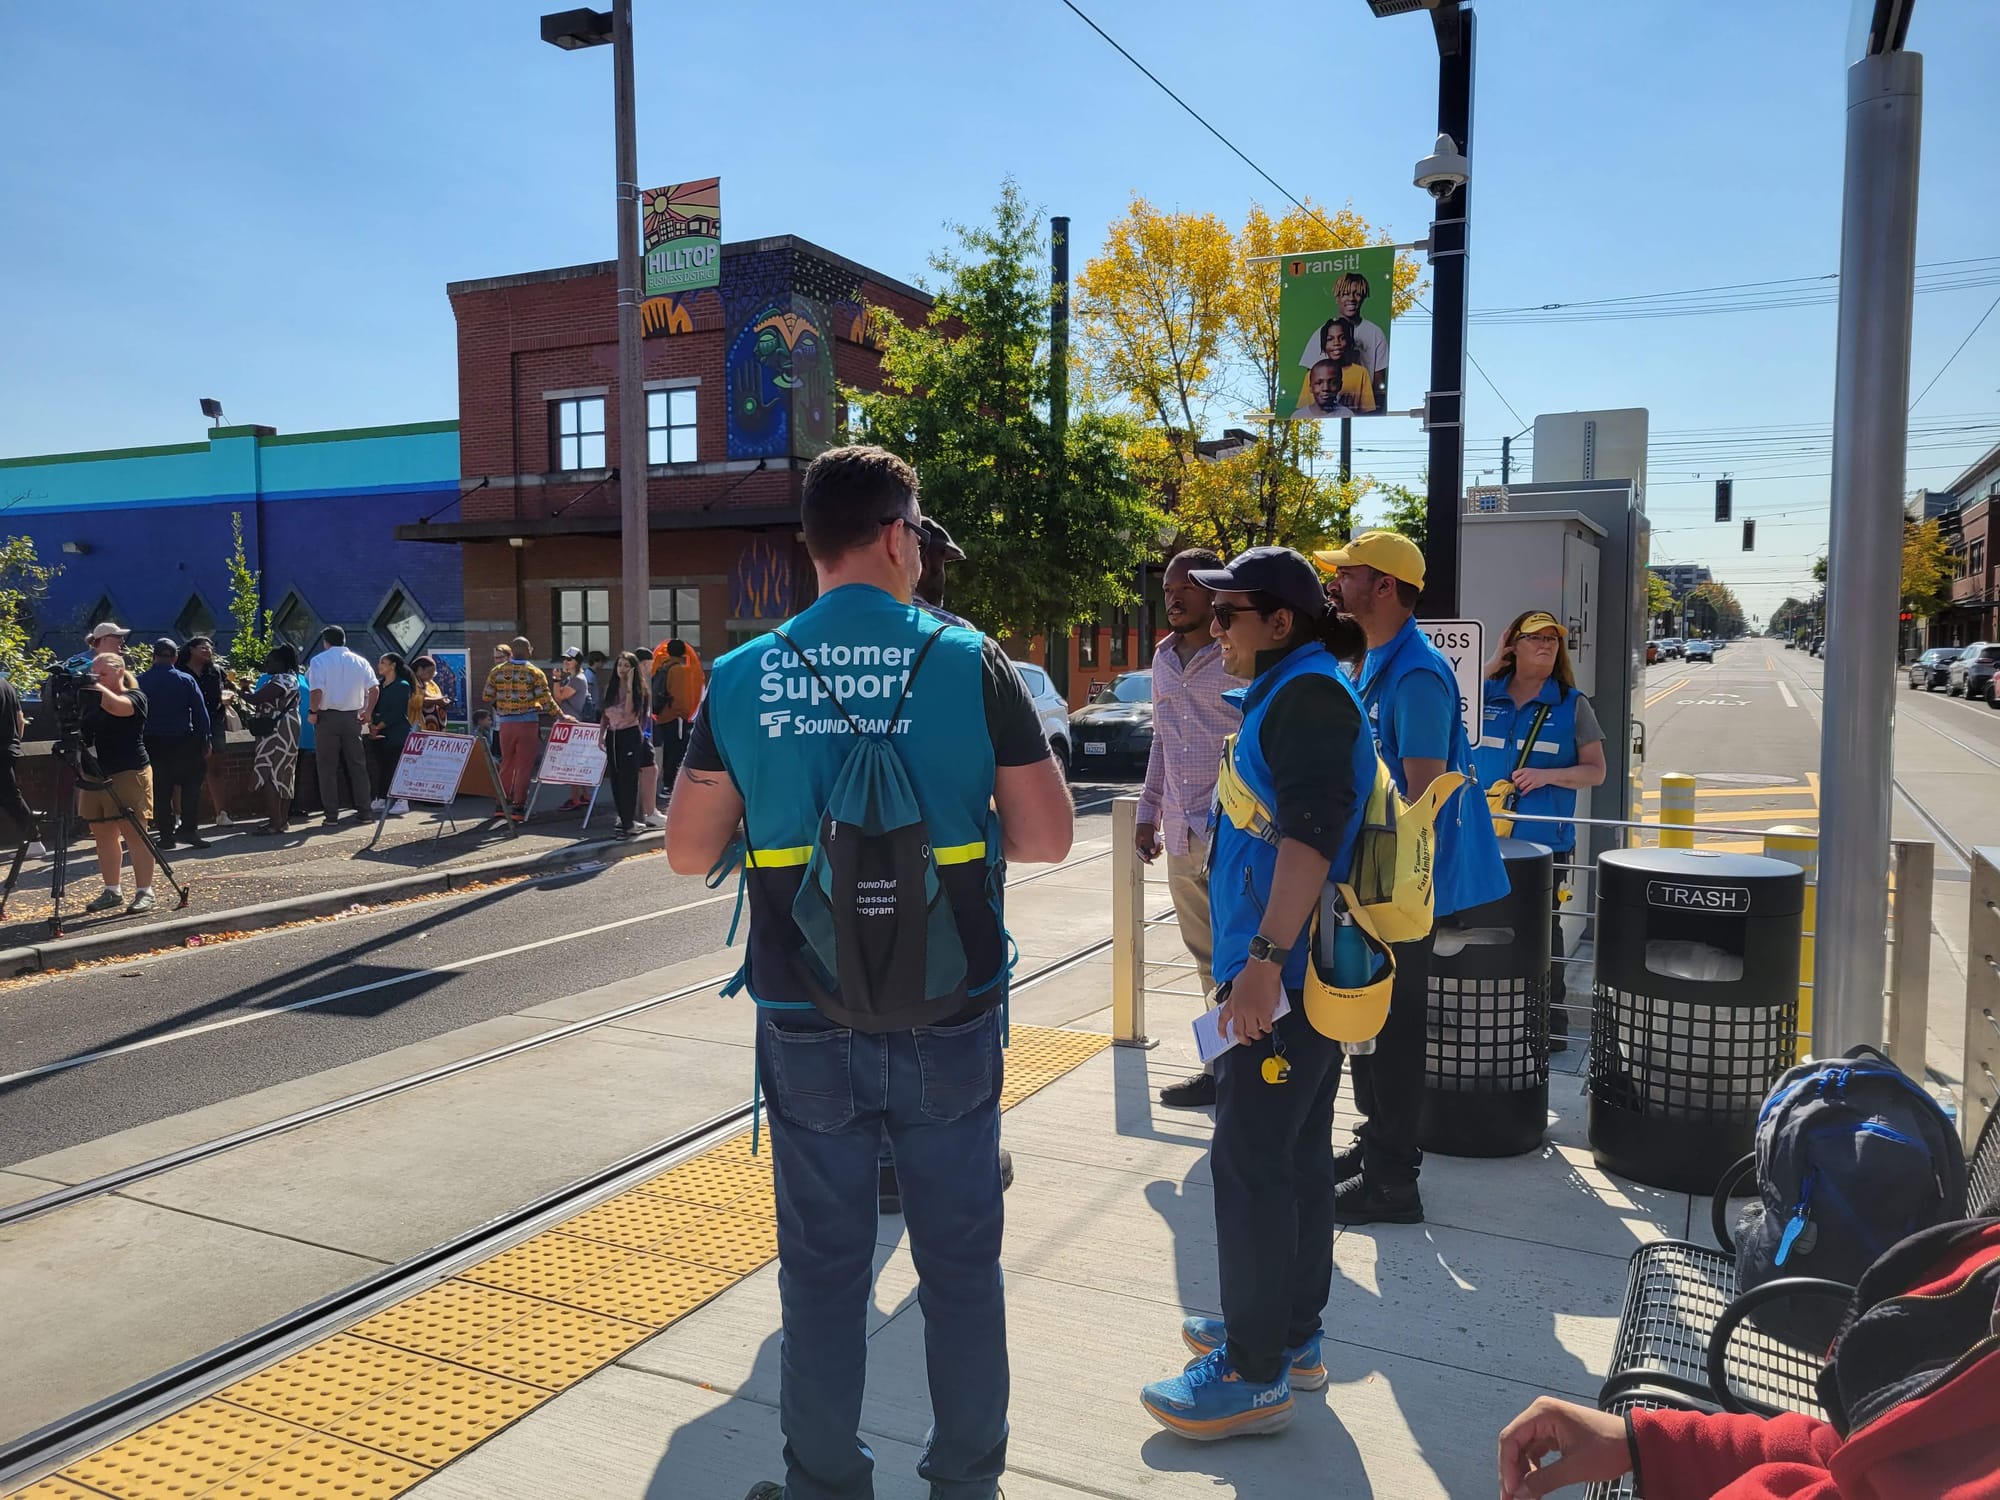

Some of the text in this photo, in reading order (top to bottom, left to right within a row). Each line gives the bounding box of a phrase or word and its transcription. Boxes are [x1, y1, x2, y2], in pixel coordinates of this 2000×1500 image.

[648, 244, 717, 274] HILLTOP
[1292, 254, 1360, 275] Transit!
[649, 268, 716, 288] BUSINESS DISTRICT
[1425, 632, 1470, 649] OSS
[760, 643, 915, 672] Customer
[759, 670, 913, 706] Support
[552, 727, 600, 741] NO PARKI
[406, 736, 469, 754] NO PARKING
[1417, 826, 1430, 892] Fare Ambassador
[857, 880, 897, 889] OUNDTRA
[857, 895, 897, 904] bassad
[1661, 886, 1736, 908] TRASH
[1252, 1382, 1289, 1408] HOKA
